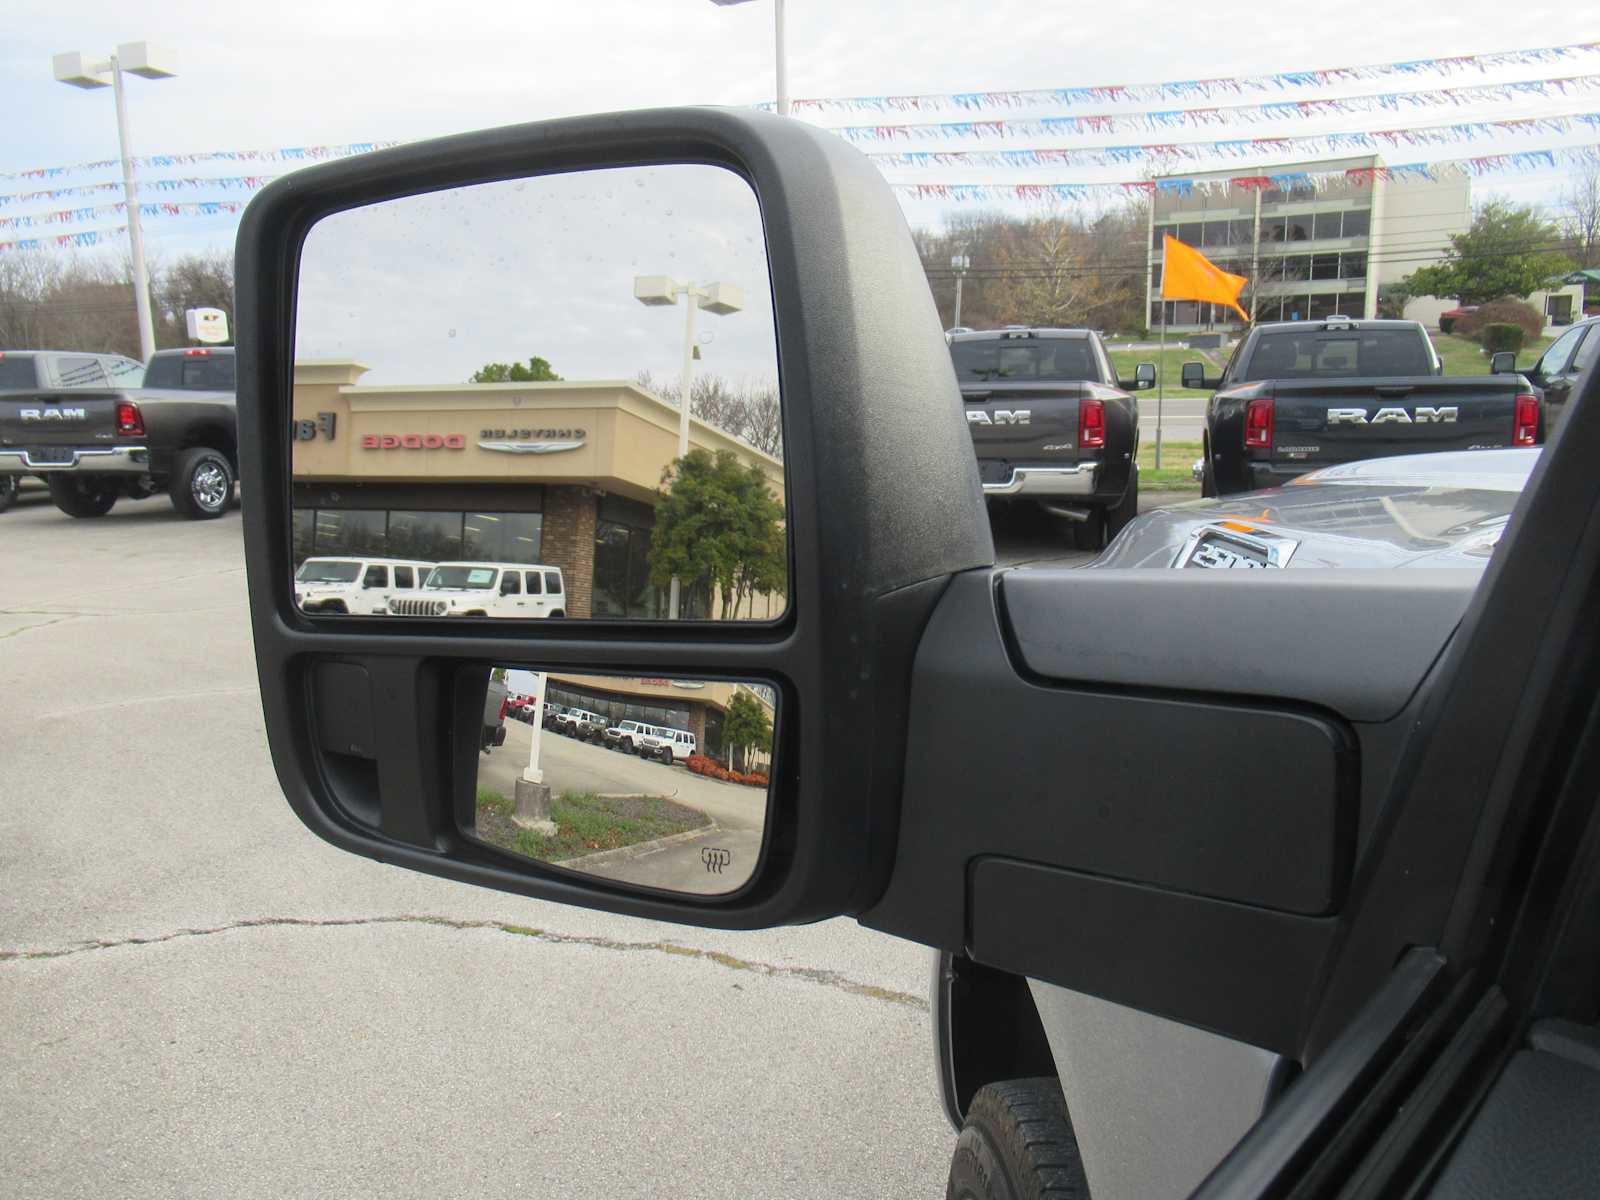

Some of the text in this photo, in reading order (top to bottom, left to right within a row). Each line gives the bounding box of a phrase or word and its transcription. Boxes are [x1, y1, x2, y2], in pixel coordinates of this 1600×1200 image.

[20, 407, 86, 421] RAM
[965, 410, 1031, 425] AM
[1326, 406, 1459, 425] RAM
